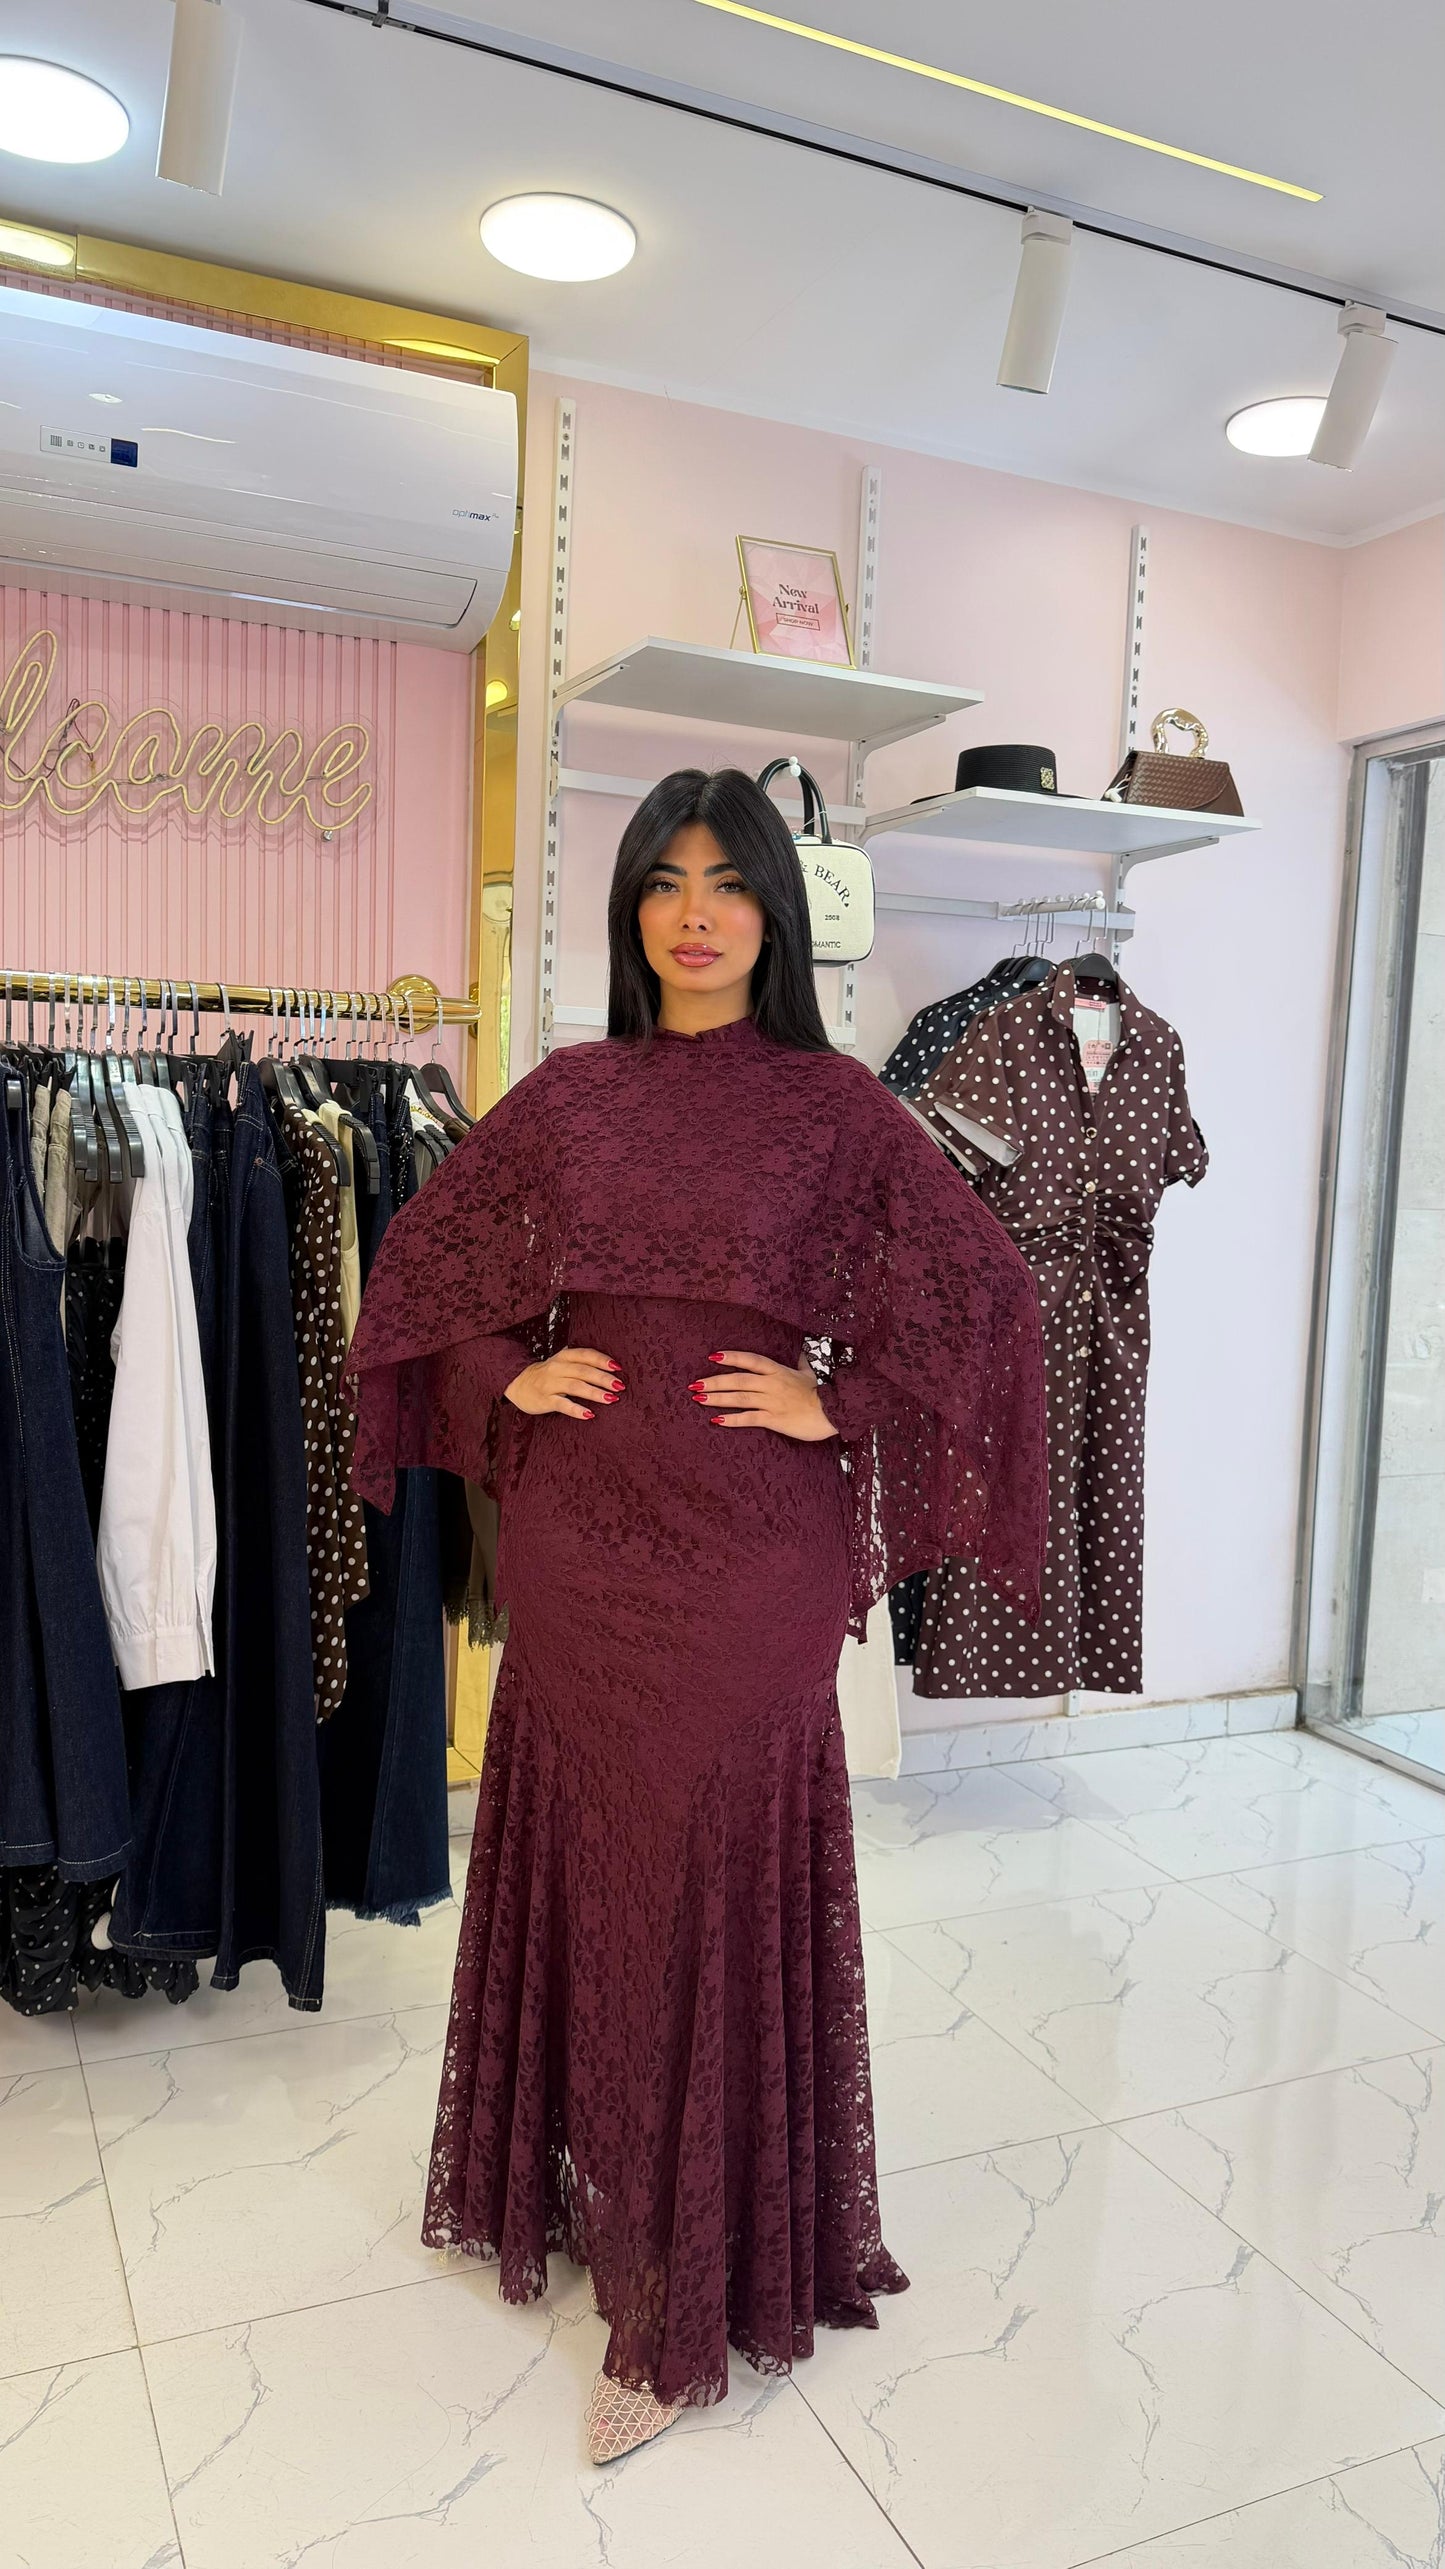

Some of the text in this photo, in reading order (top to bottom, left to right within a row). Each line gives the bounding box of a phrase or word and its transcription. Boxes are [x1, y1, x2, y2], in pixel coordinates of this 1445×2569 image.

[779, 584, 808, 598] New
[772, 597, 819, 614] Arrival
[0, 630, 372, 830] lcome
